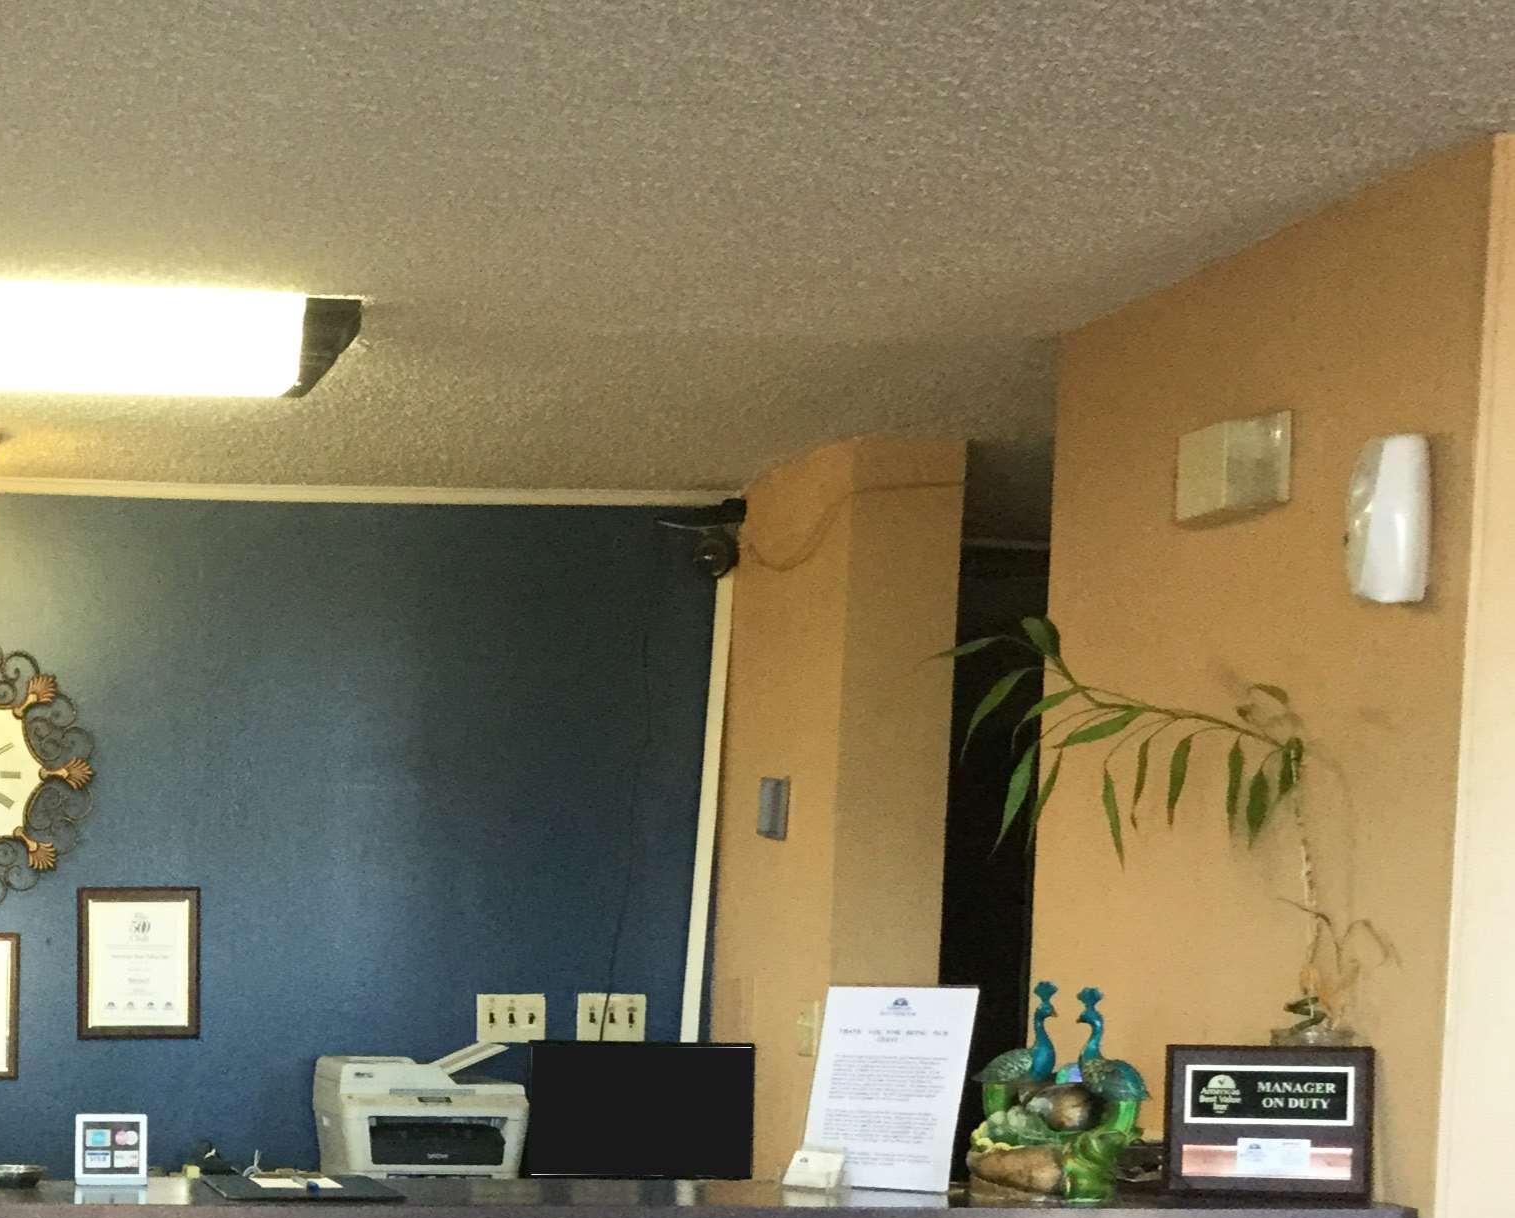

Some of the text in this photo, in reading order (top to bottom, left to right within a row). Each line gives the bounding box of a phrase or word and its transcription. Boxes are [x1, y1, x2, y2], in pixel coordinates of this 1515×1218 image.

[1257, 1081, 1336, 1094] MANAGER
[1261, 1097, 1330, 1109] ON DUTY
